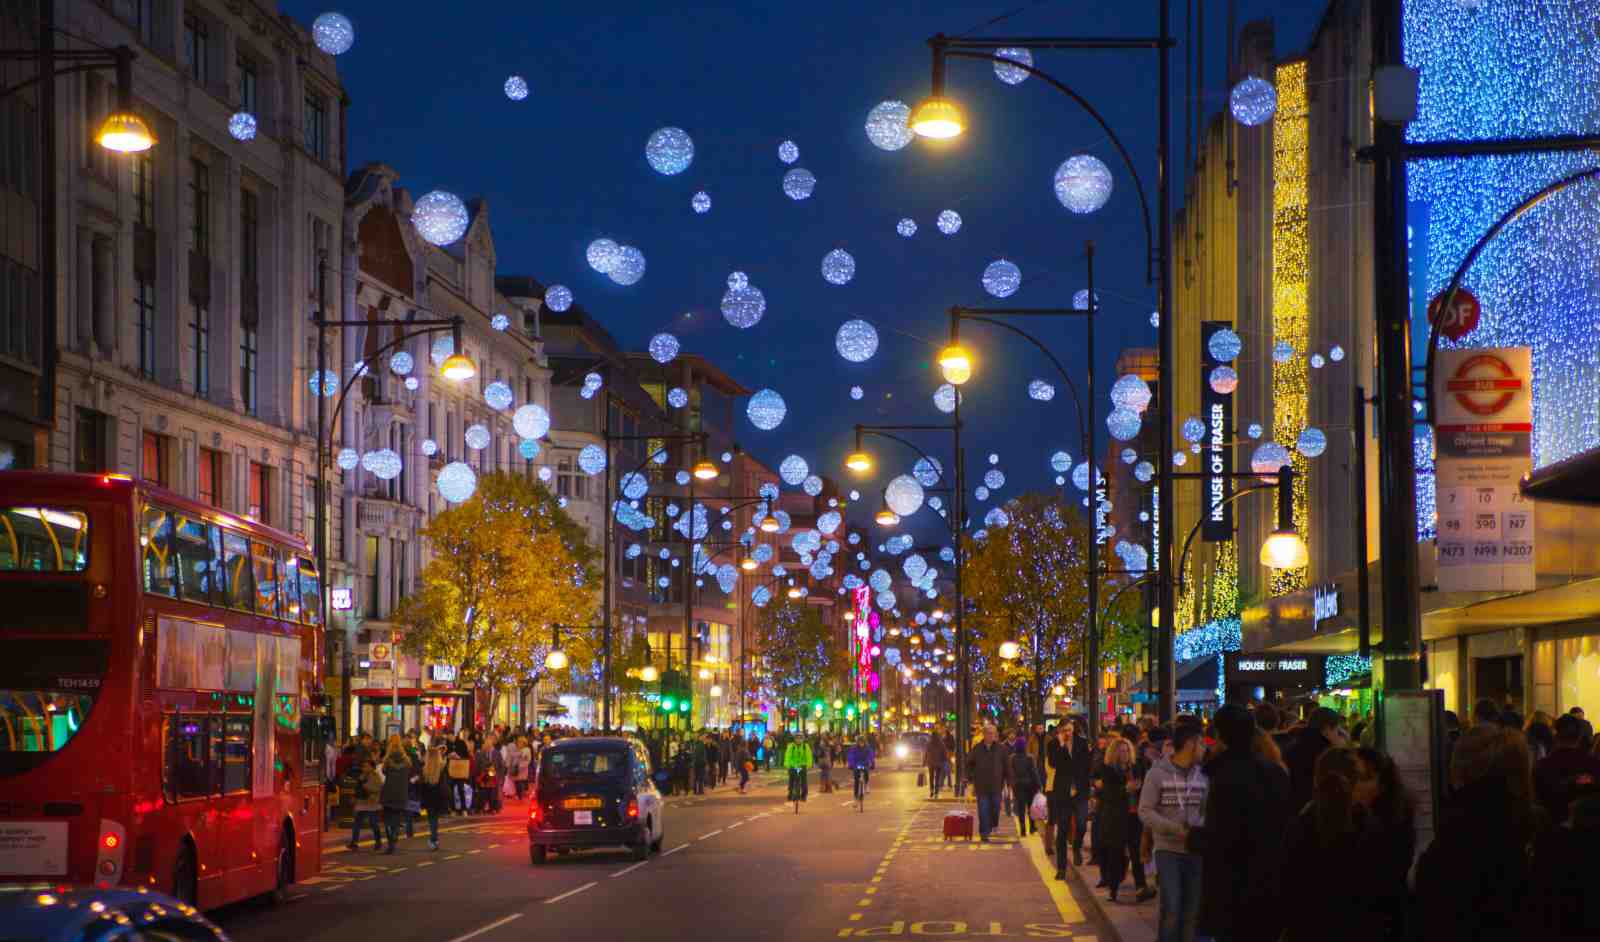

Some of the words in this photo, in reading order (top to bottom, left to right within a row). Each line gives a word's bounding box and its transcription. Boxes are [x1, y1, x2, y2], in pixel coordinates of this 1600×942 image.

[1211, 403, 1224, 452] FRASER
[1211, 454, 1224, 475] OF
[1211, 476, 1224, 522] HOUSE
[1479, 493, 1492, 504] 10
[1510, 519, 1526, 529] N7
[1503, 545, 1533, 555] N207
[1238, 660, 1265, 671] HOUSE
[1266, 660, 1277, 671] OF
[1278, 660, 1308, 671] FRASER
[853, 920, 1073, 938] STOP
